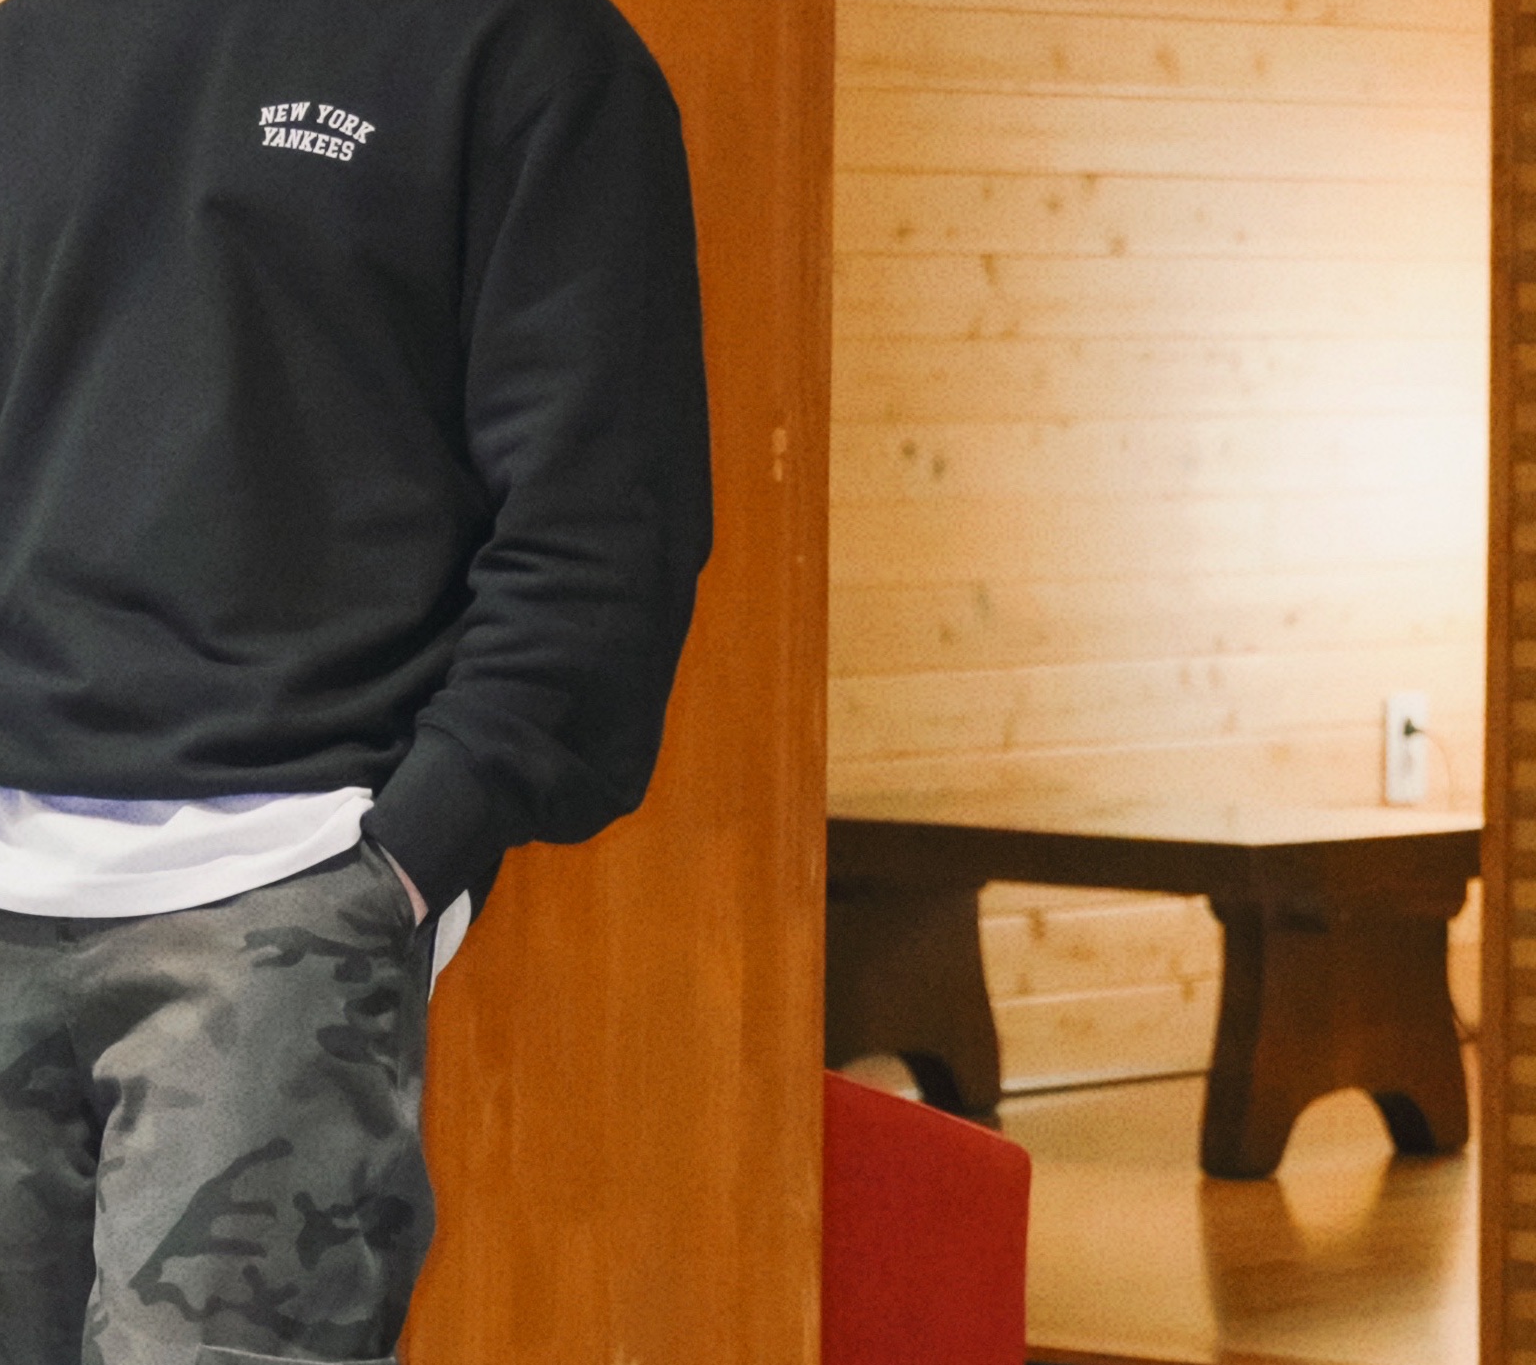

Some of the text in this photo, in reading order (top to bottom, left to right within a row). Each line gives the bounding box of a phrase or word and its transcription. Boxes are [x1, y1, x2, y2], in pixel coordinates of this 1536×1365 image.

[258, 101, 376, 145] NEW YORK
[262, 126, 355, 162] YANKEES
